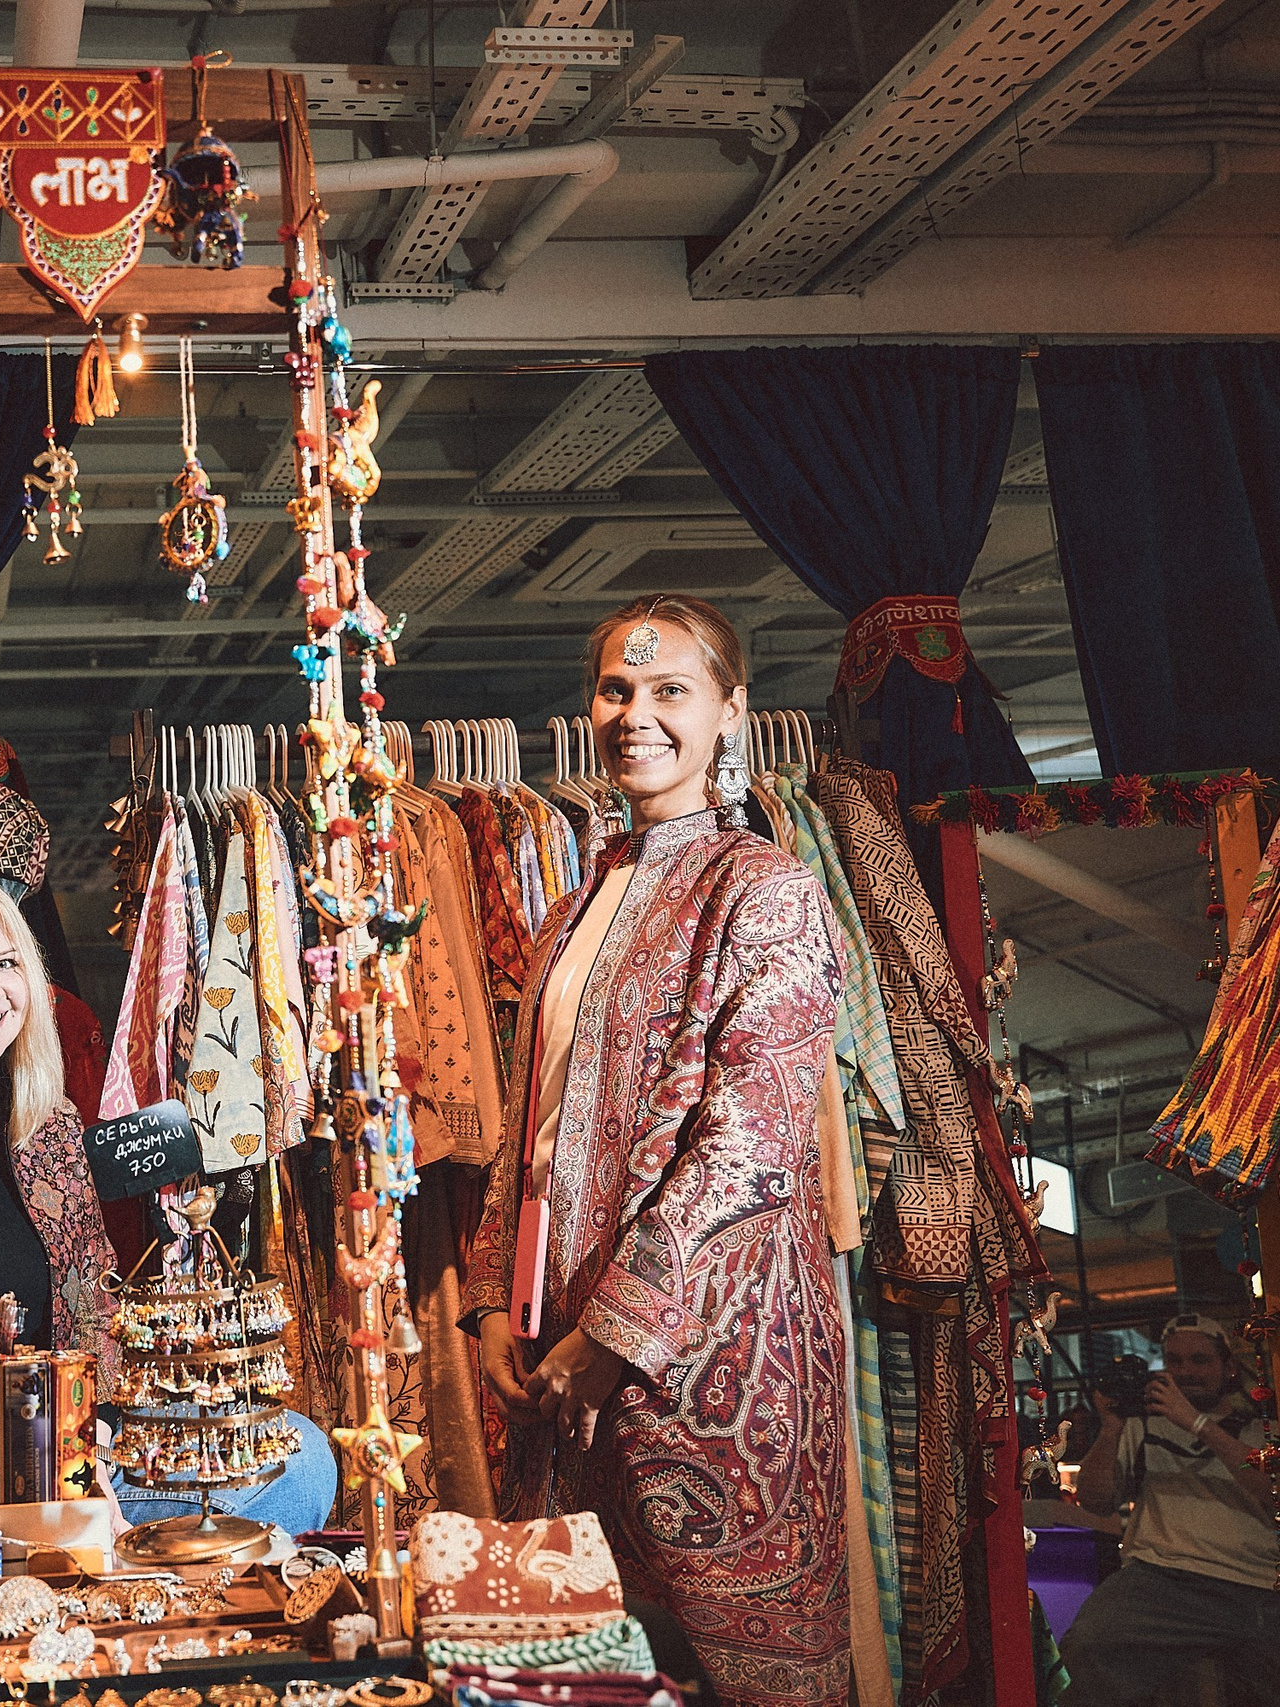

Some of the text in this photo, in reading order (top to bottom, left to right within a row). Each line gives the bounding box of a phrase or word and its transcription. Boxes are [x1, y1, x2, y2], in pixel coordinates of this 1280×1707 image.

[30, 157, 130, 207] लाभ
[114, 1125, 186, 1161] ДЖУМКИ
[128, 1151, 167, 1177] 750
